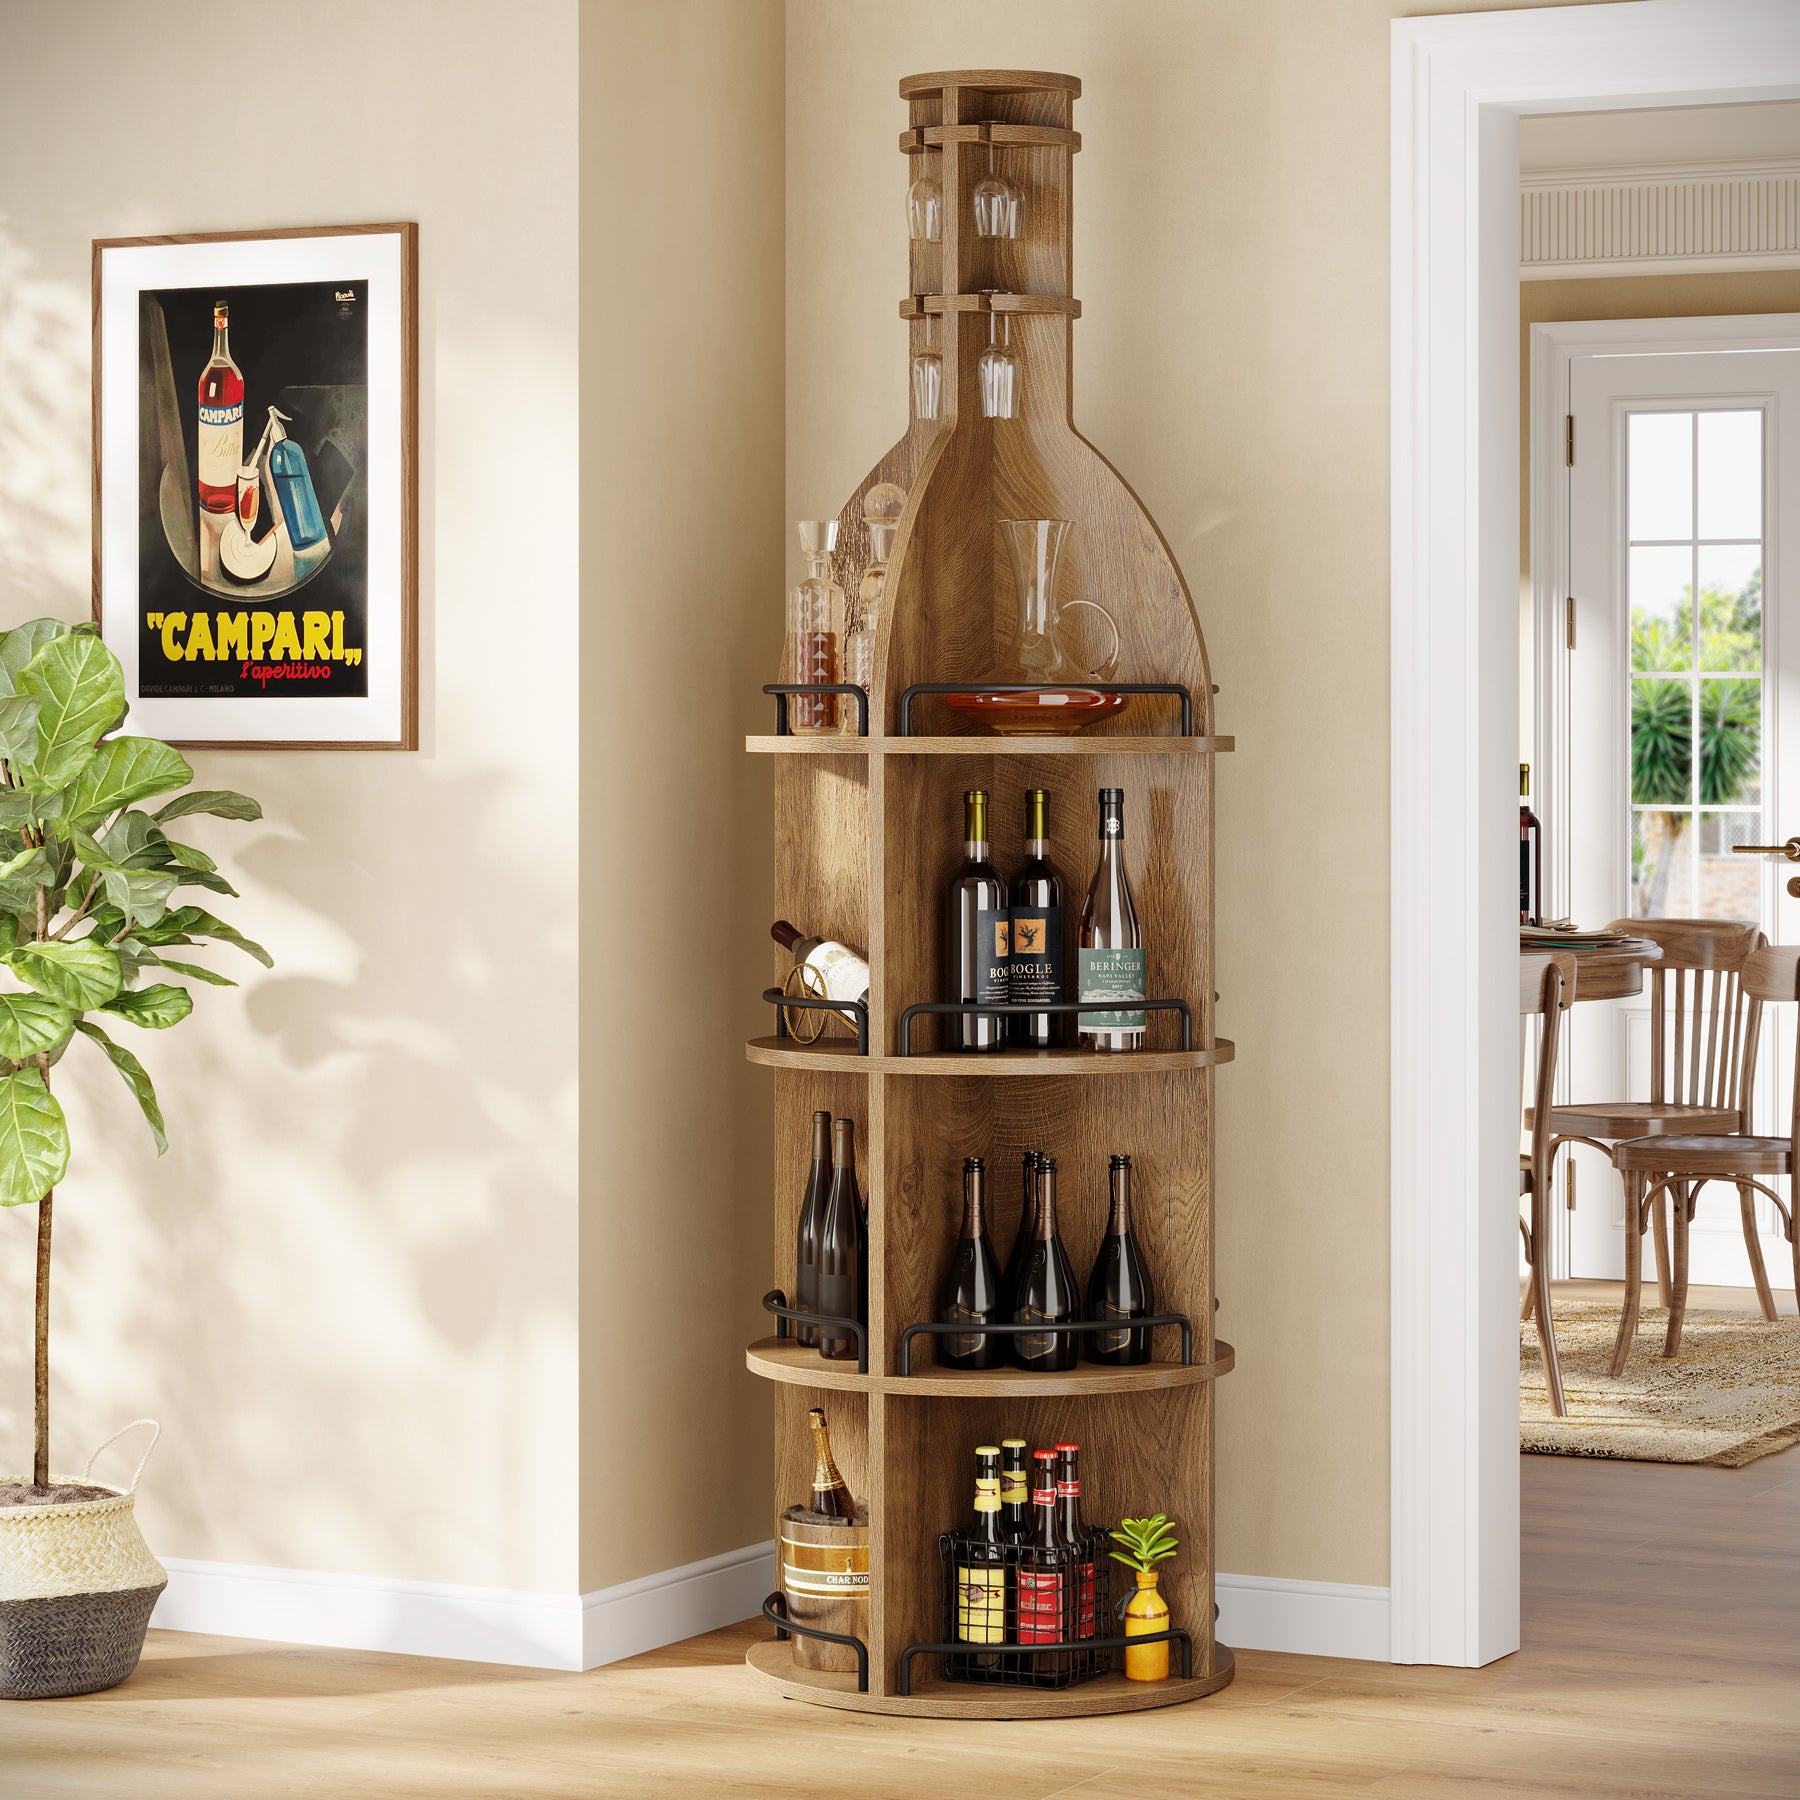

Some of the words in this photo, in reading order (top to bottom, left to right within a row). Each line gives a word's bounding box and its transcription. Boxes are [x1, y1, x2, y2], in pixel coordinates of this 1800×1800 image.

[200, 405, 242, 424] CAMPARI
[239, 660, 331, 688] l'aperitivo
[141, 685, 164, 693] DAVIDE
[164, 685, 193, 693] CAMPARI
[1010, 963, 1053, 974] BOGLE
[1090, 961, 1142, 971] BERINGER
[826, 1574, 851, 1584] CHAR
